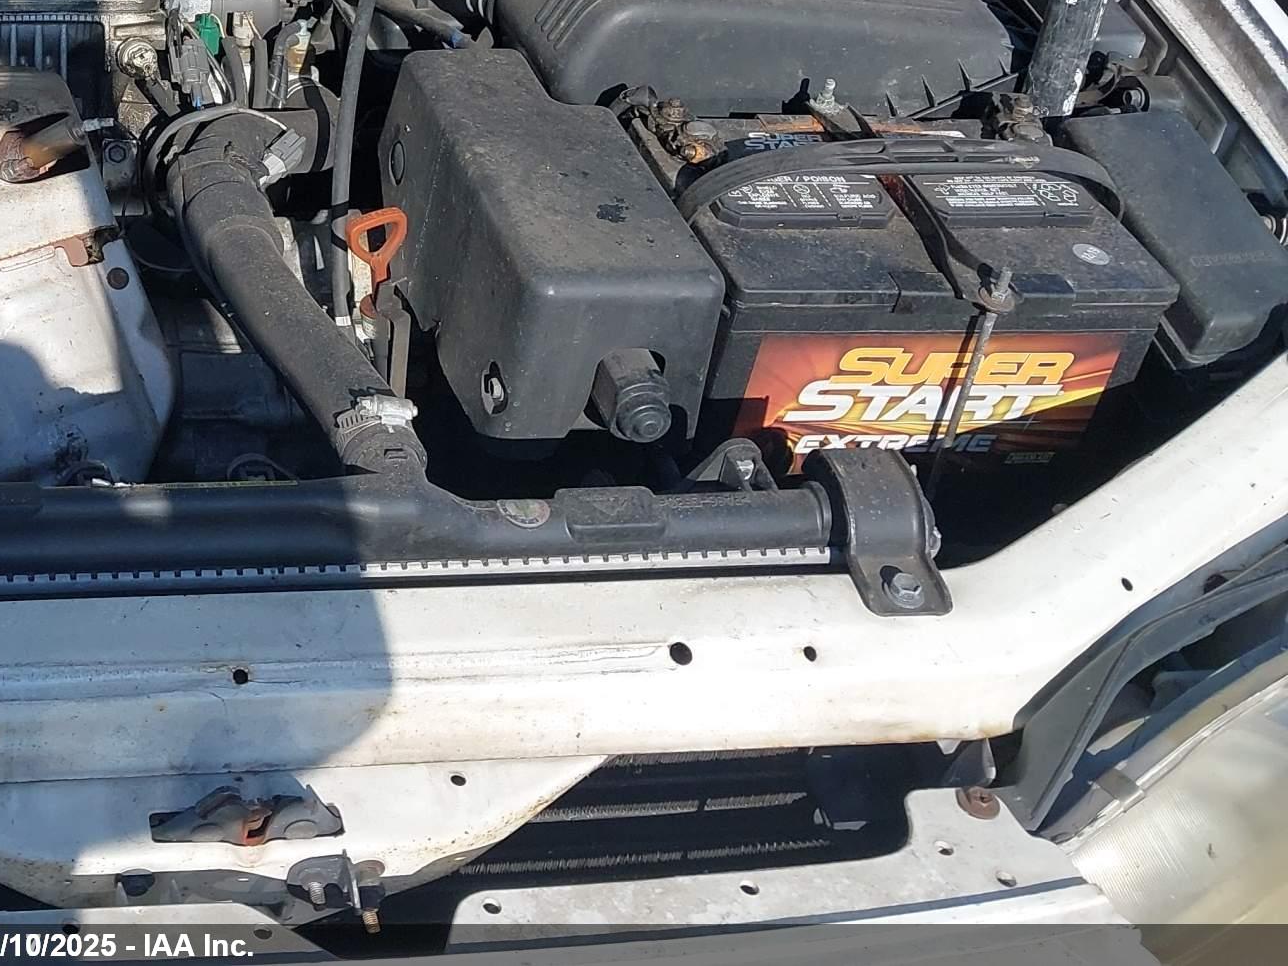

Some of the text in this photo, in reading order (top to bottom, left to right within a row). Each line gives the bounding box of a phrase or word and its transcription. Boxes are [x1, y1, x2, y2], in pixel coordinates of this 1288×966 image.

[748, 132, 823, 143] SUPER
[803, 175, 846, 184] POISON
[831, 346, 1075, 385] SUPER
[782, 379, 1065, 423] START
[794, 433, 1000, 455] EXTREME
